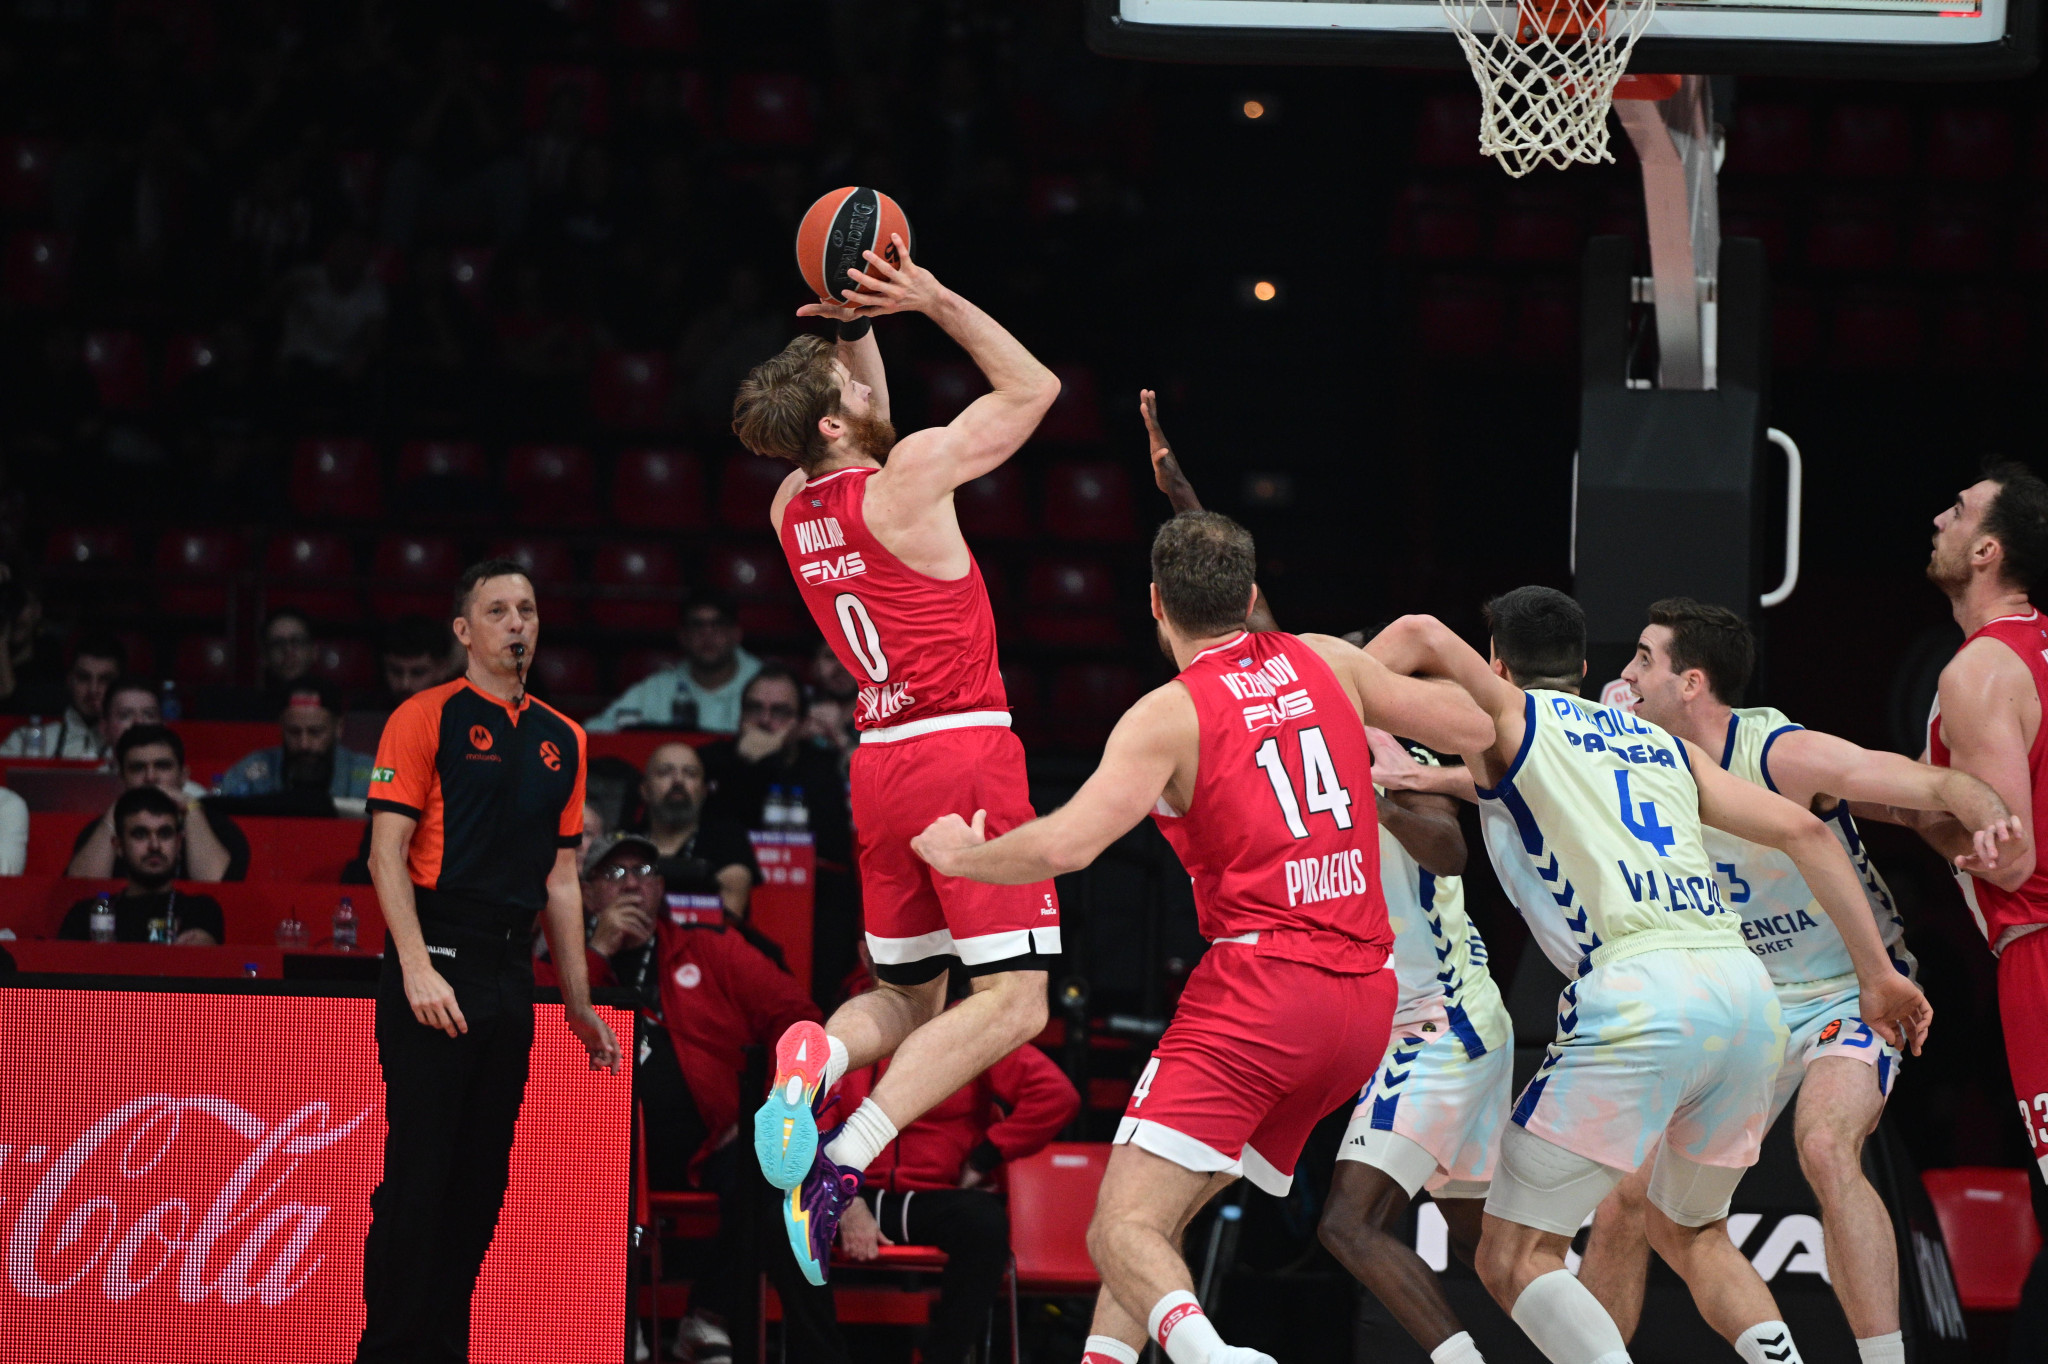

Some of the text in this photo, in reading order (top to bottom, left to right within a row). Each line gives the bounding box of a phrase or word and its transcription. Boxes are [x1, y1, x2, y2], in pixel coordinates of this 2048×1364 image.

[800, 551, 866, 584] FMS
[835, 592, 889, 684] 0
[1243, 689, 1314, 730] FMS
[1255, 725, 1354, 840] 14
[1614, 770, 1676, 858] 4
[1284, 849, 1367, 907] PIRAEUS
[1161, 1305, 1202, 1338] GSA
